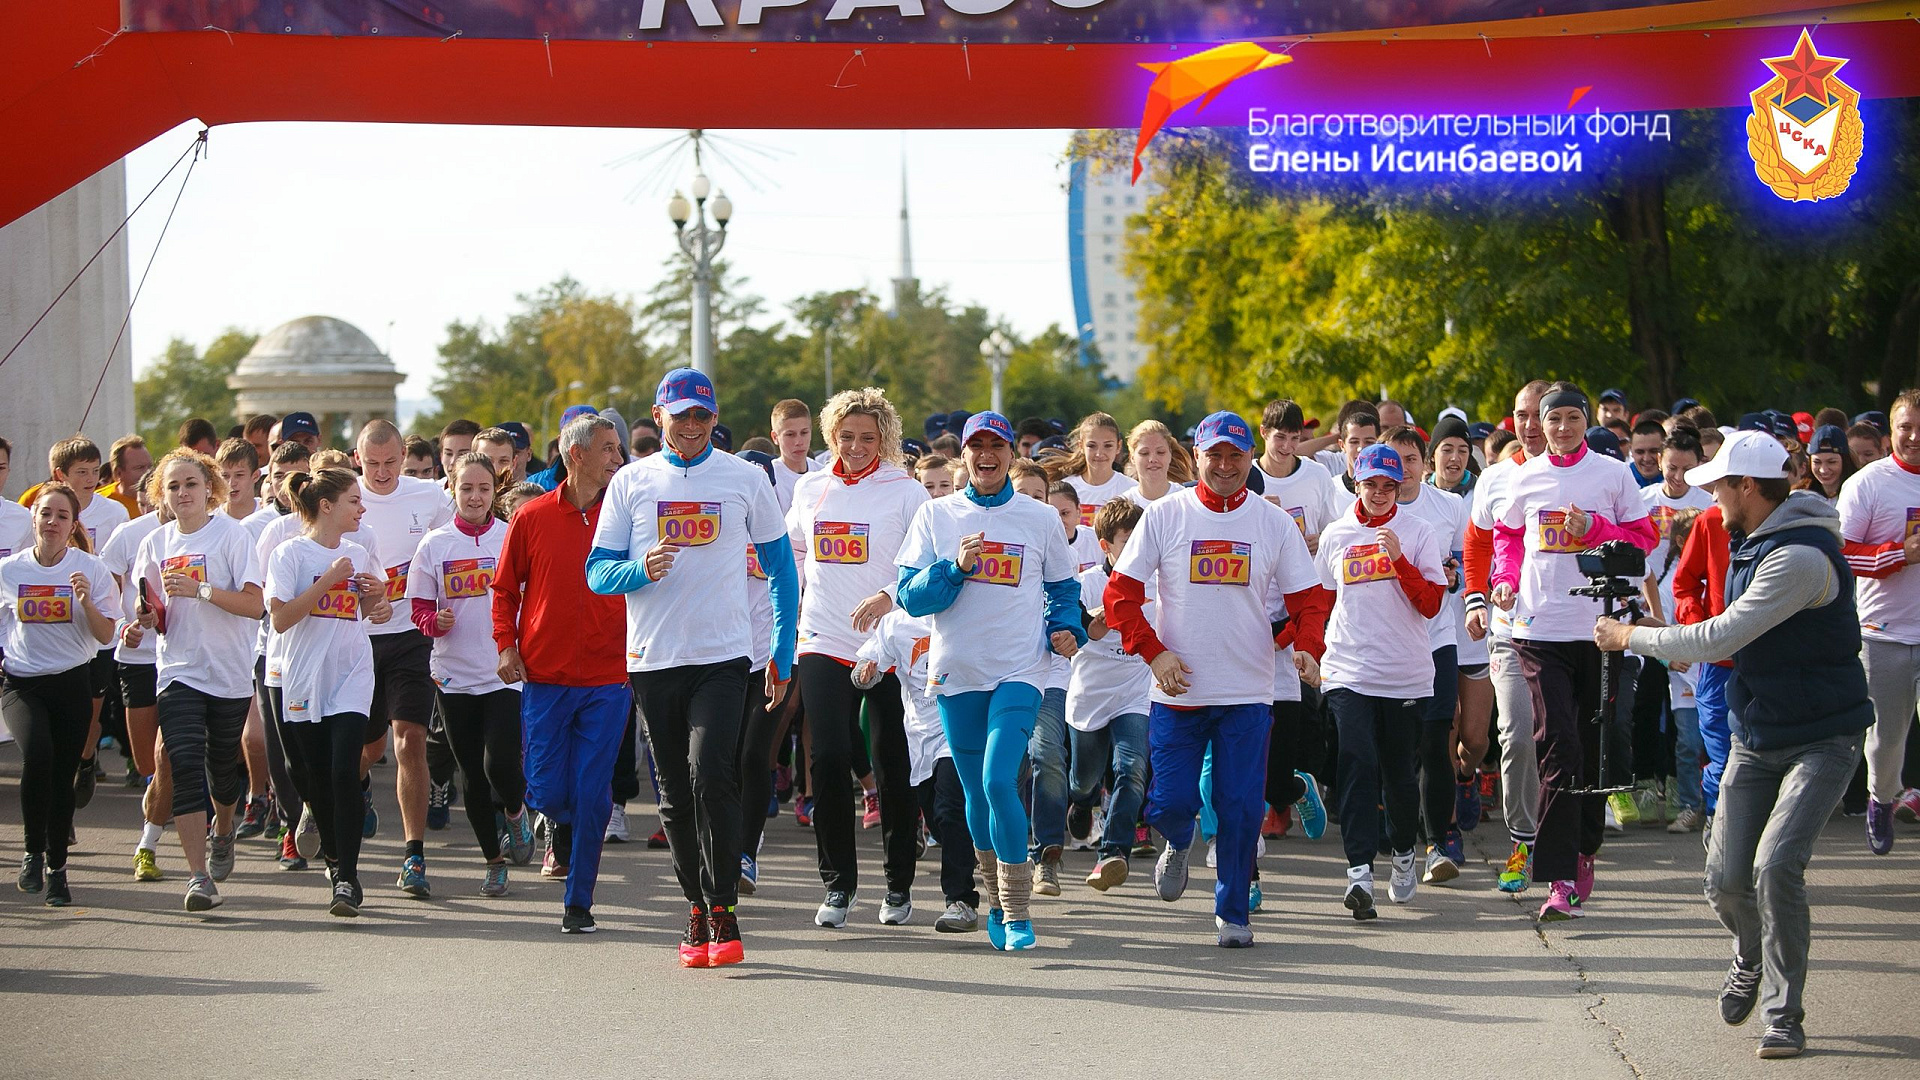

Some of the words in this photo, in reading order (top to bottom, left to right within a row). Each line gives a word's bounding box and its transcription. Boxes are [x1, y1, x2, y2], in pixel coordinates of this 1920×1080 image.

[665, 518, 715, 539] 009
[819, 537, 863, 558] 006
[1198, 557, 1244, 578] 007
[1348, 556, 1392, 578] 008
[450, 572, 491, 593] 040
[23, 599, 67, 617] 063
[317, 593, 356, 614] 042
